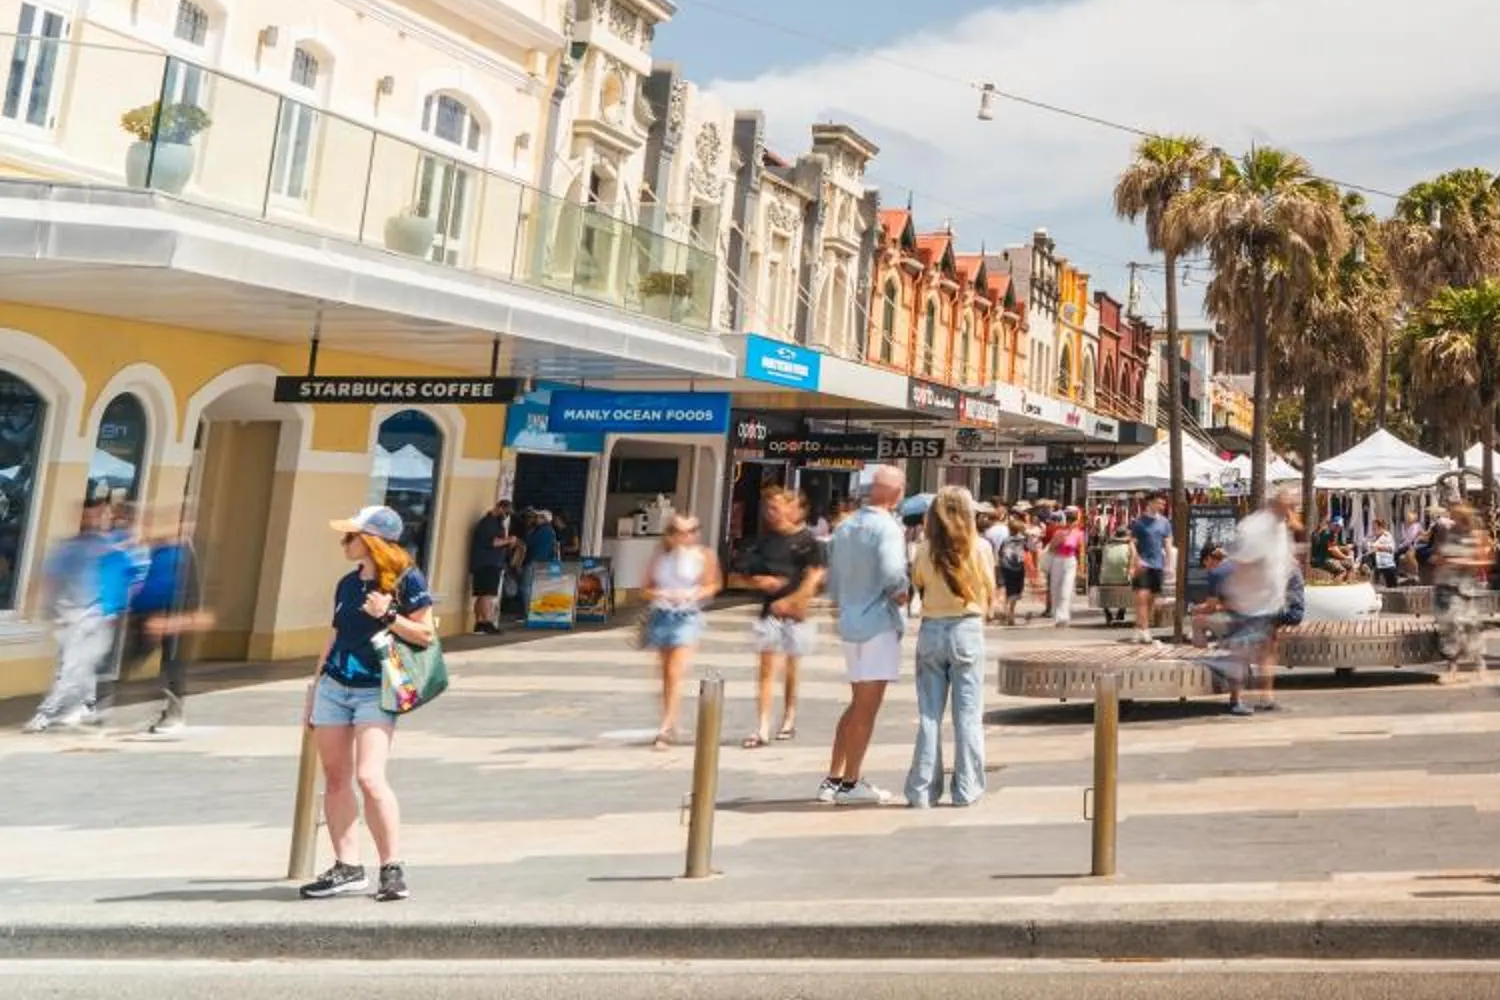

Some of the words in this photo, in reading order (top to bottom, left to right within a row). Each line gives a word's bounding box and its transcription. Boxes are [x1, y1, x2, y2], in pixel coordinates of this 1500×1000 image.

[299, 381, 417, 397] STARBUCKS
[421, 382, 494, 397] COFFEE
[563, 408, 609, 421] MANLY
[613, 408, 661, 421] OCEAN
[666, 409, 714, 422] FOODS
[769, 440, 821, 454] oporto
